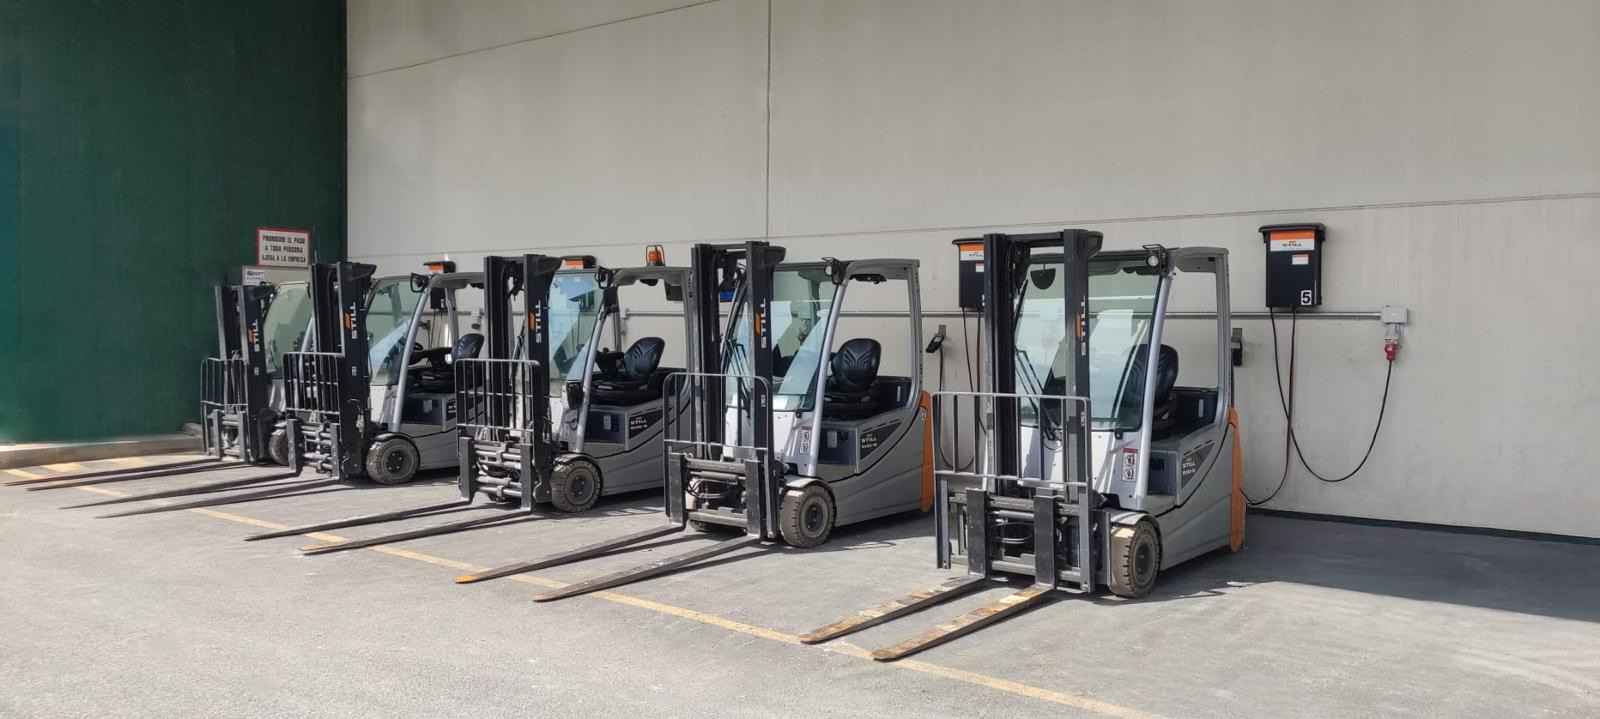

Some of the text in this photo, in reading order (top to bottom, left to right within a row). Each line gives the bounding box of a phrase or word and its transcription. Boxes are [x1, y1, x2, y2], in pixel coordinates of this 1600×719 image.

[294, 237, 305, 245] PASO
[1302, 291, 1310, 304] 5
[252, 319, 260, 352] STILL
